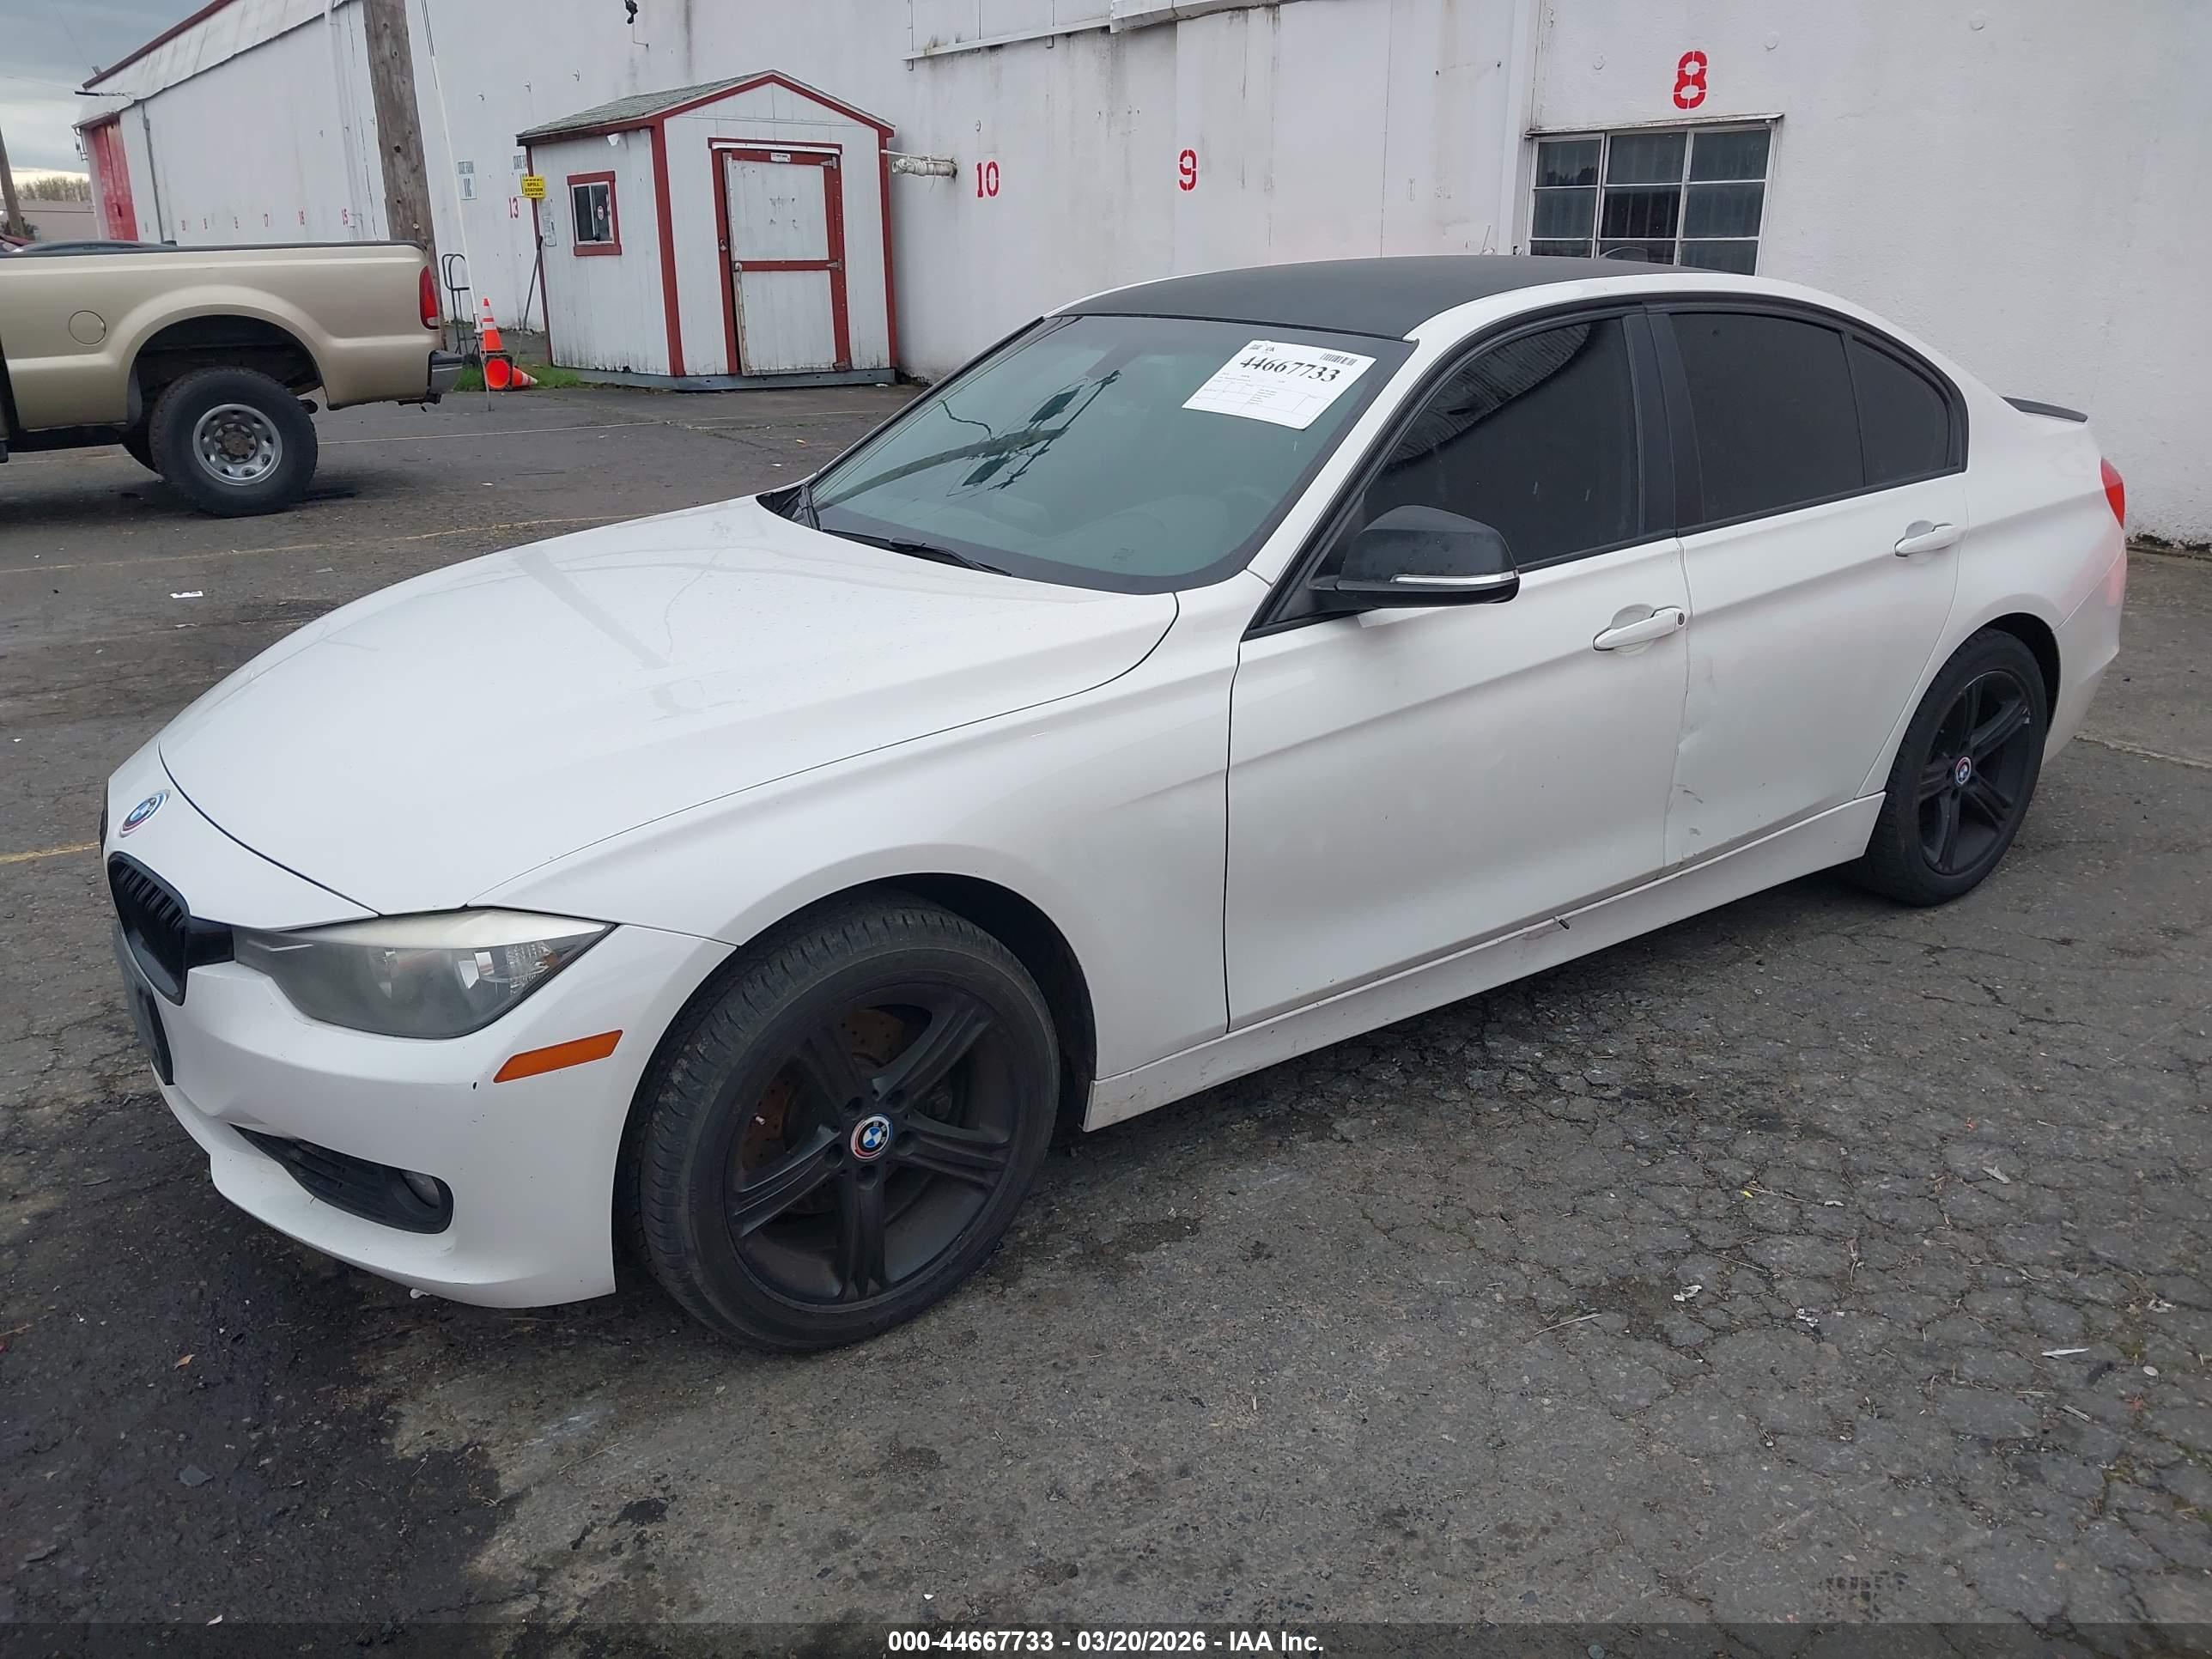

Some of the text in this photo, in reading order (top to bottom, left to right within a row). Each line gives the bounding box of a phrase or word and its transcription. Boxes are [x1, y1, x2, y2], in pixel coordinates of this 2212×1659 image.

[1673, 51, 1708, 110] 8
[976, 161, 999, 198] 10
[1179, 149, 1197, 191] 9
[508, 197, 519, 218] 13
[1240, 356, 1340, 382] 44667733
